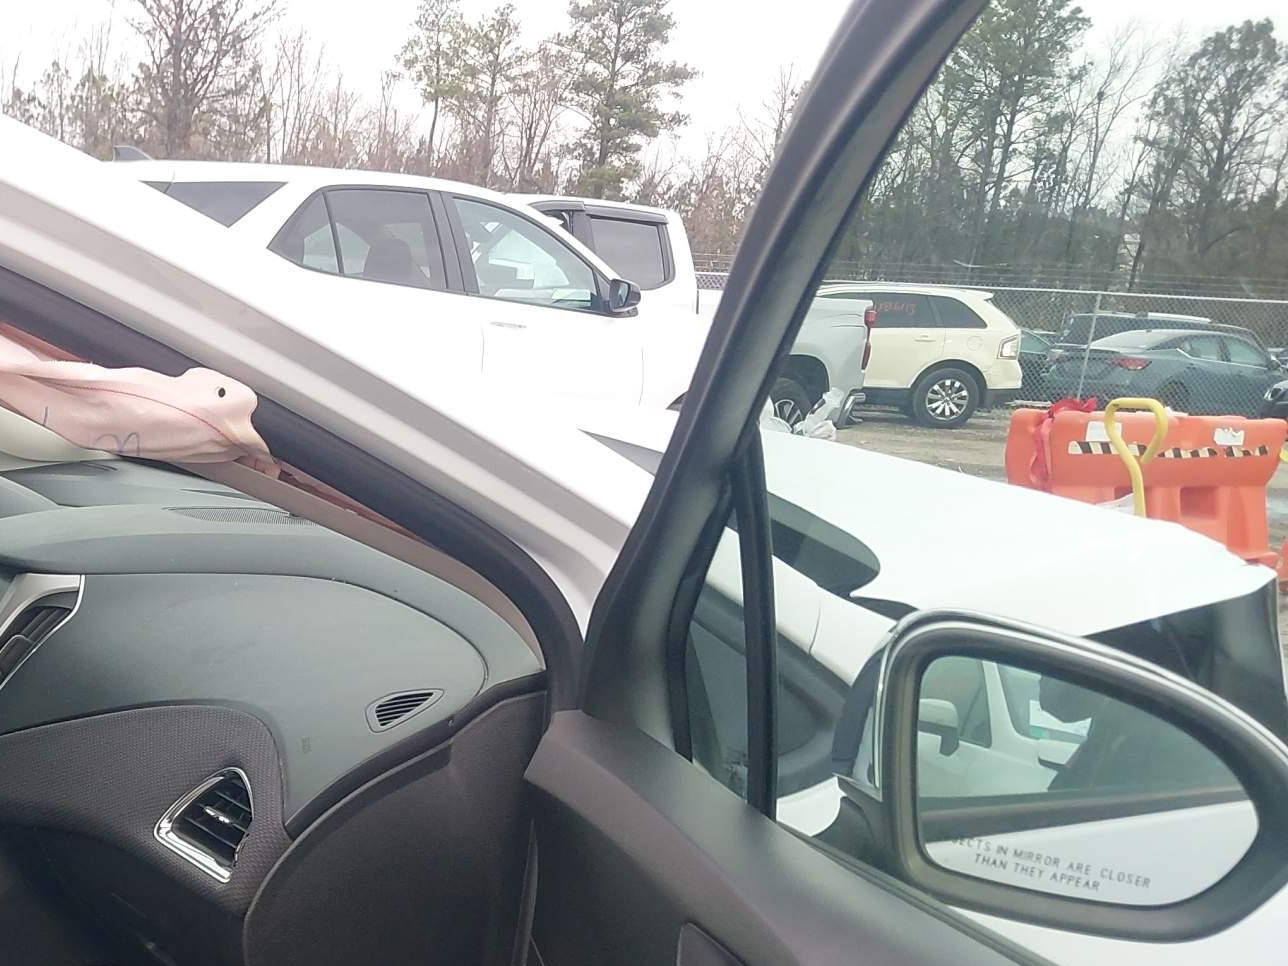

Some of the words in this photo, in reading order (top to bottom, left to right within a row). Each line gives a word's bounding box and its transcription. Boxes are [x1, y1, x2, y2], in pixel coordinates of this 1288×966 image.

[975, 853, 1007, 870] THAN
[1014, 862, 1044, 878] THEY
[1050, 871, 1100, 892] APPEAR
[996, 845, 1009, 856] IN
[1014, 848, 1060, 868] MIRROR
[1066, 862, 1092, 876] ARE
[1100, 867, 1151, 889] CLOSER
